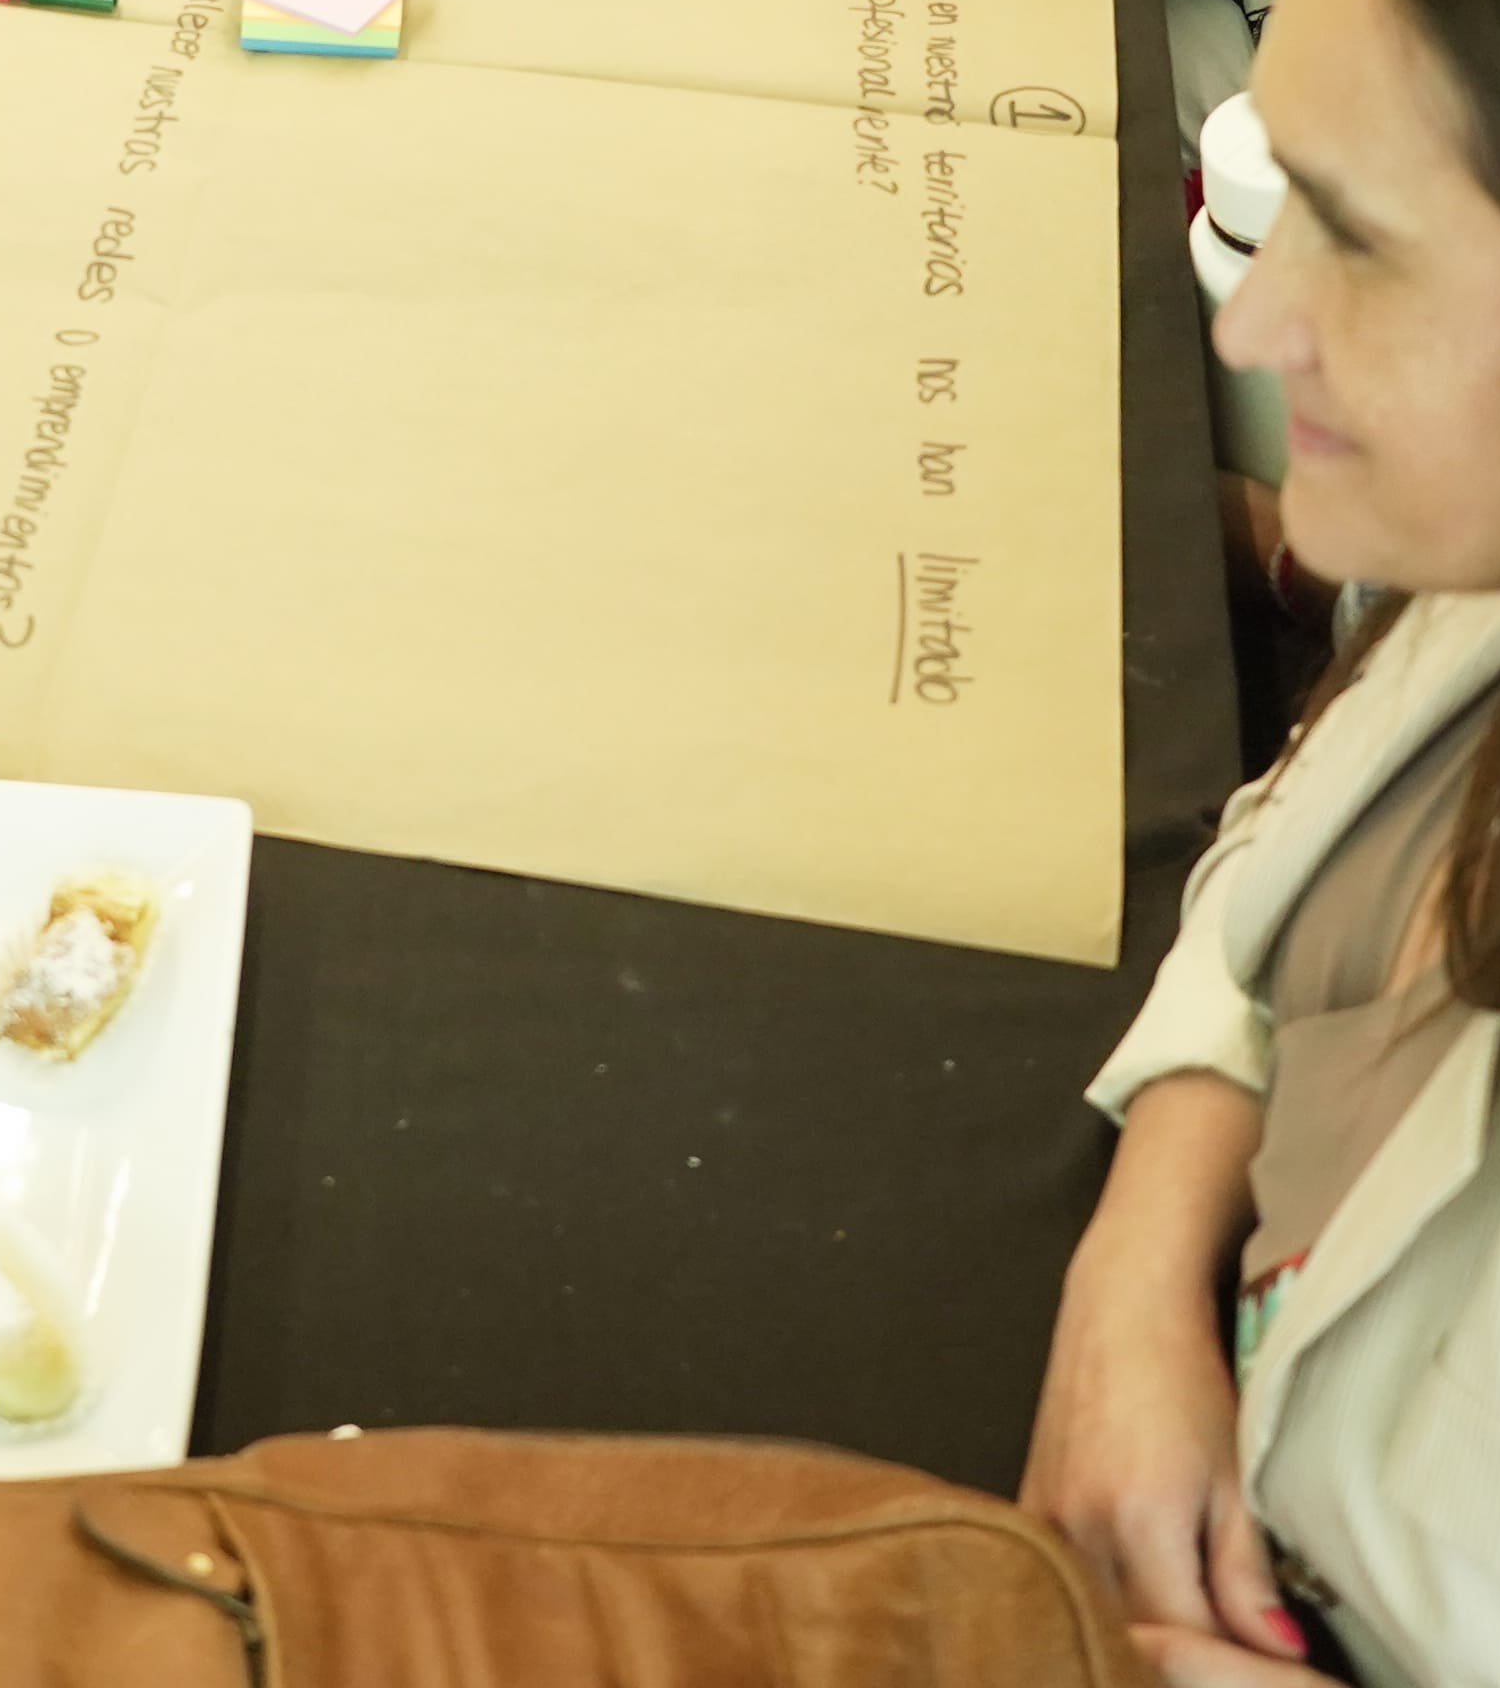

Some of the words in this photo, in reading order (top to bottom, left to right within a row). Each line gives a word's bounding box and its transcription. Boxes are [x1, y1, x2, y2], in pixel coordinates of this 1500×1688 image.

[929, 3, 960, 25] en
[119, 66, 184, 175] nuestras
[1009, 100, 1072, 129] 1
[77, 207, 137, 304] redes
[921, 151, 966, 297] territorios
[917, 359, 960, 404] nos
[917, 442, 967, 496] han
[914, 553, 981, 704] limitado
